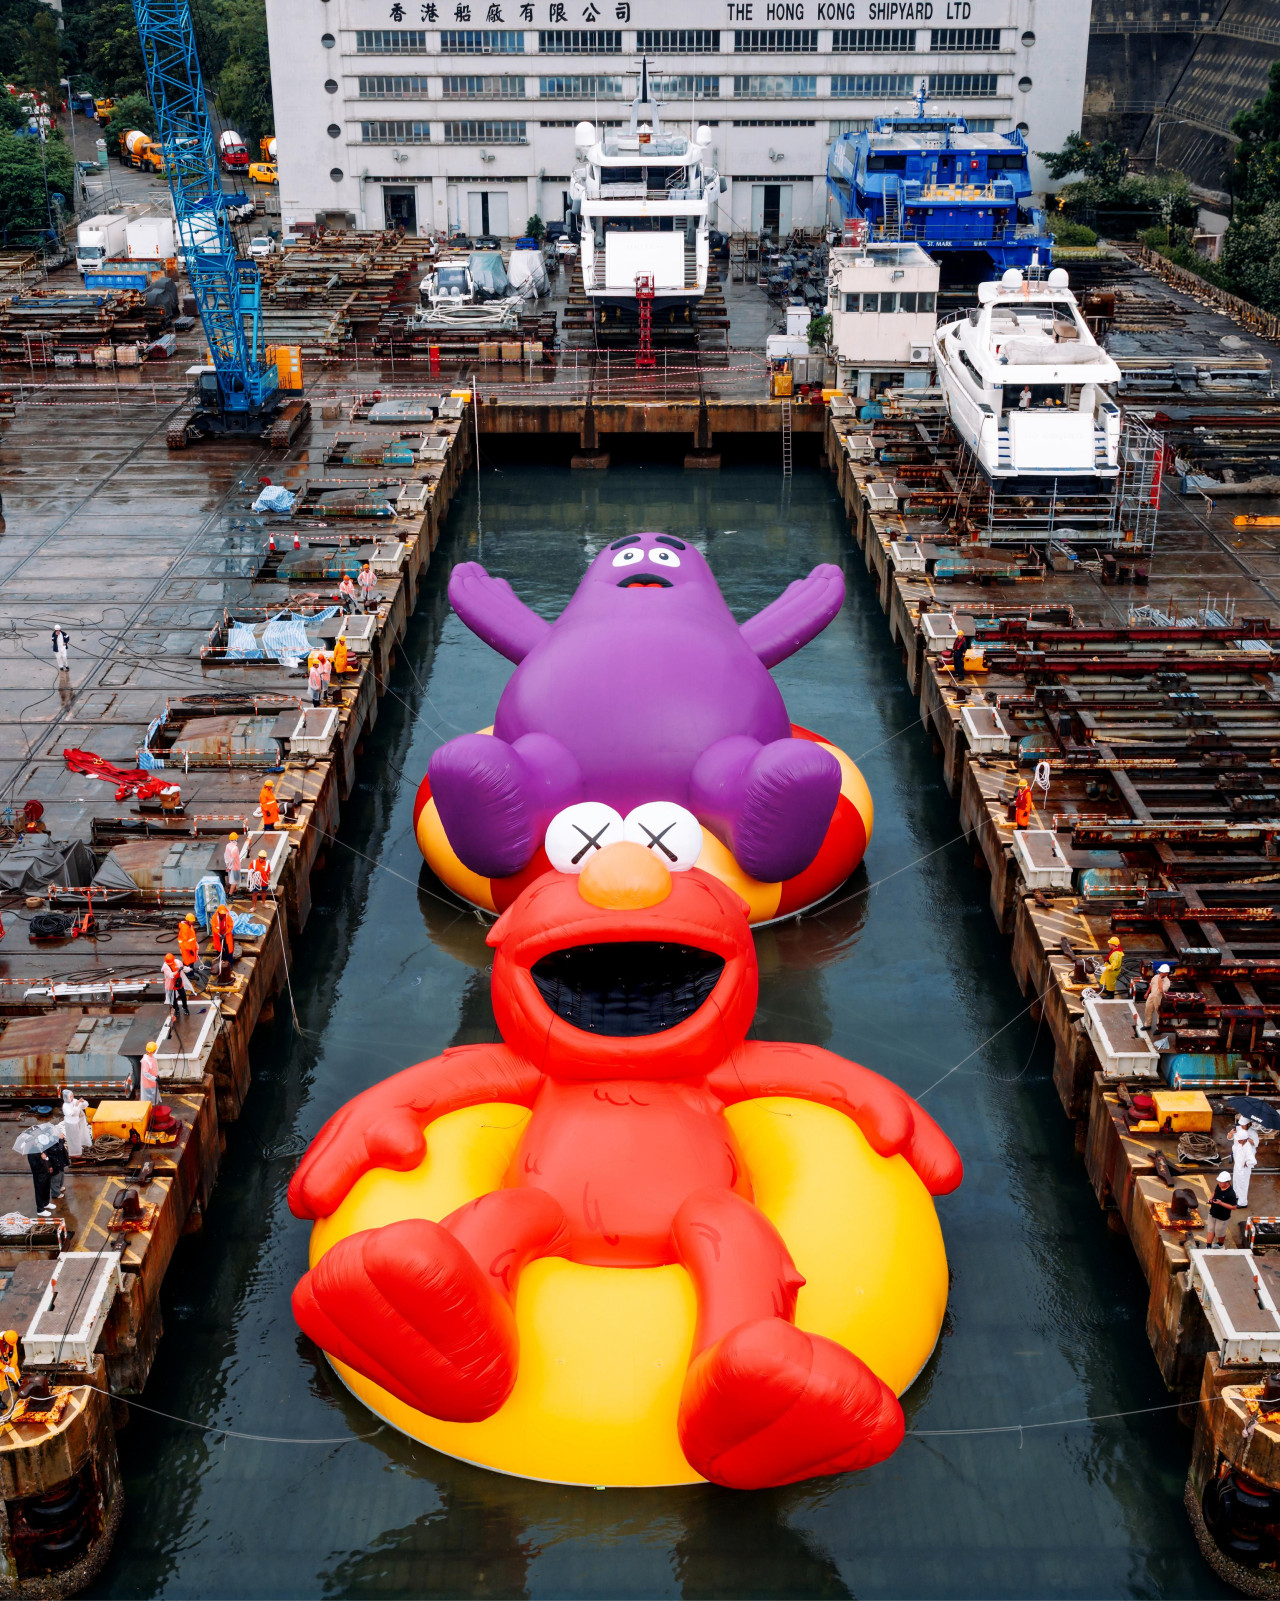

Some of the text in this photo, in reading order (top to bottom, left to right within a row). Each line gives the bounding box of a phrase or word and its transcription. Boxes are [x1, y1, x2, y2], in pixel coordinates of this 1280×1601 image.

[389, 2, 631, 23] 香港船廠有限公司
[727, 2, 972, 21] THE HONG KONG SHIPYARD LTD
